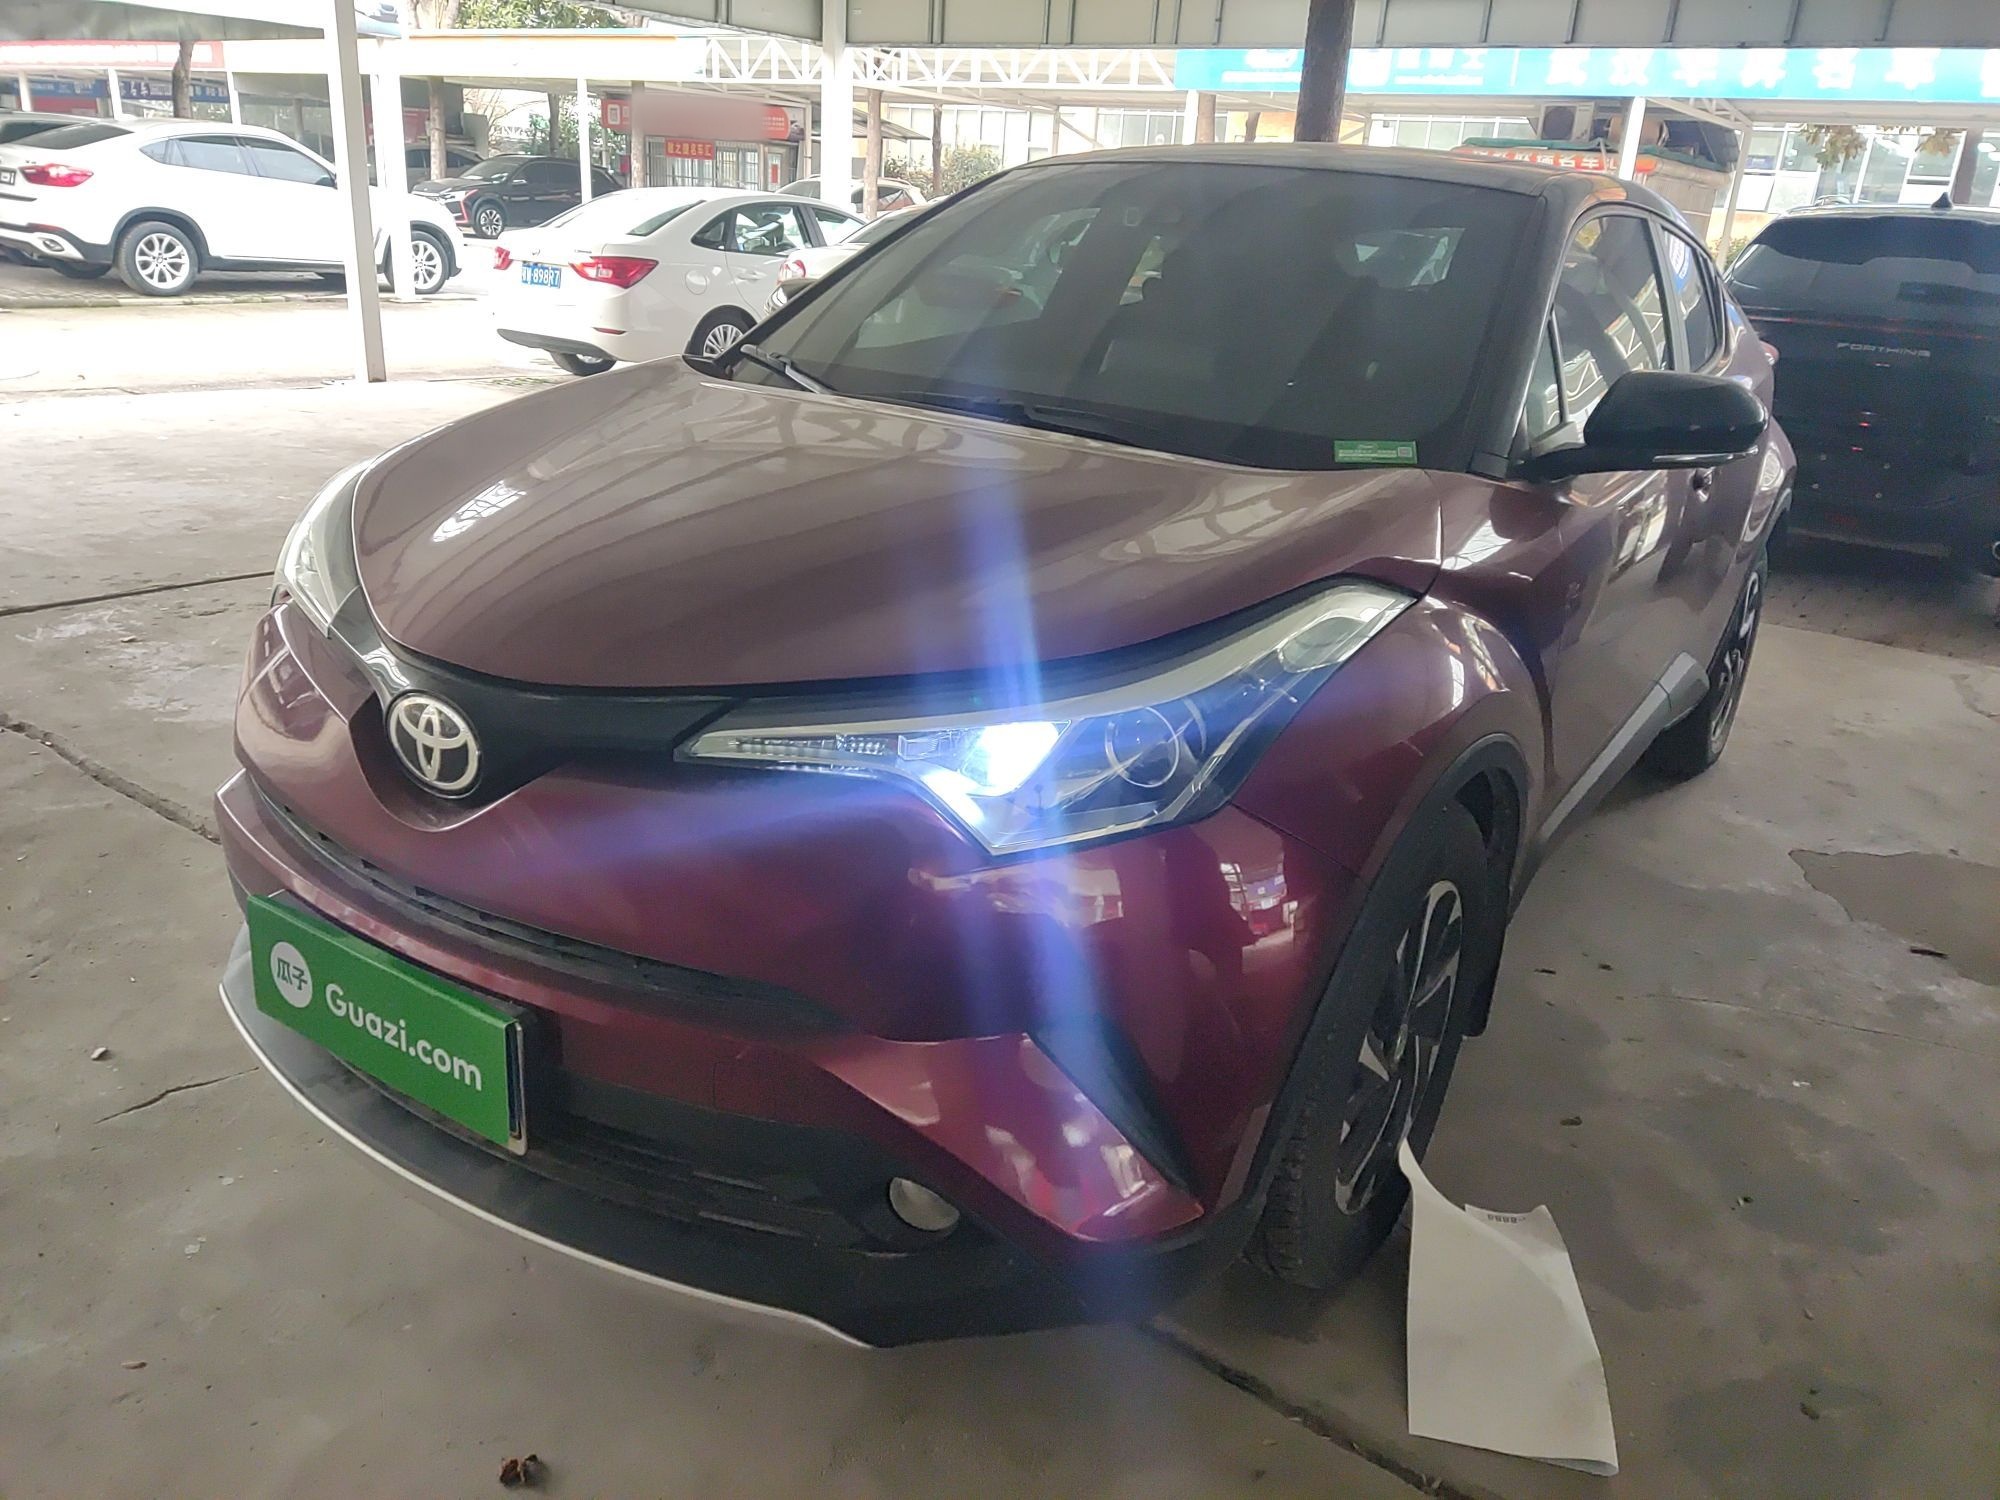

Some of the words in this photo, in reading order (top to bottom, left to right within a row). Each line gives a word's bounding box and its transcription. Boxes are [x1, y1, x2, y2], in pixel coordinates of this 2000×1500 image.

[1836, 342, 1931, 358] FORTHING
[276, 956, 309, 992] 瓜子
[324, 983, 482, 1092] Guazi.com
